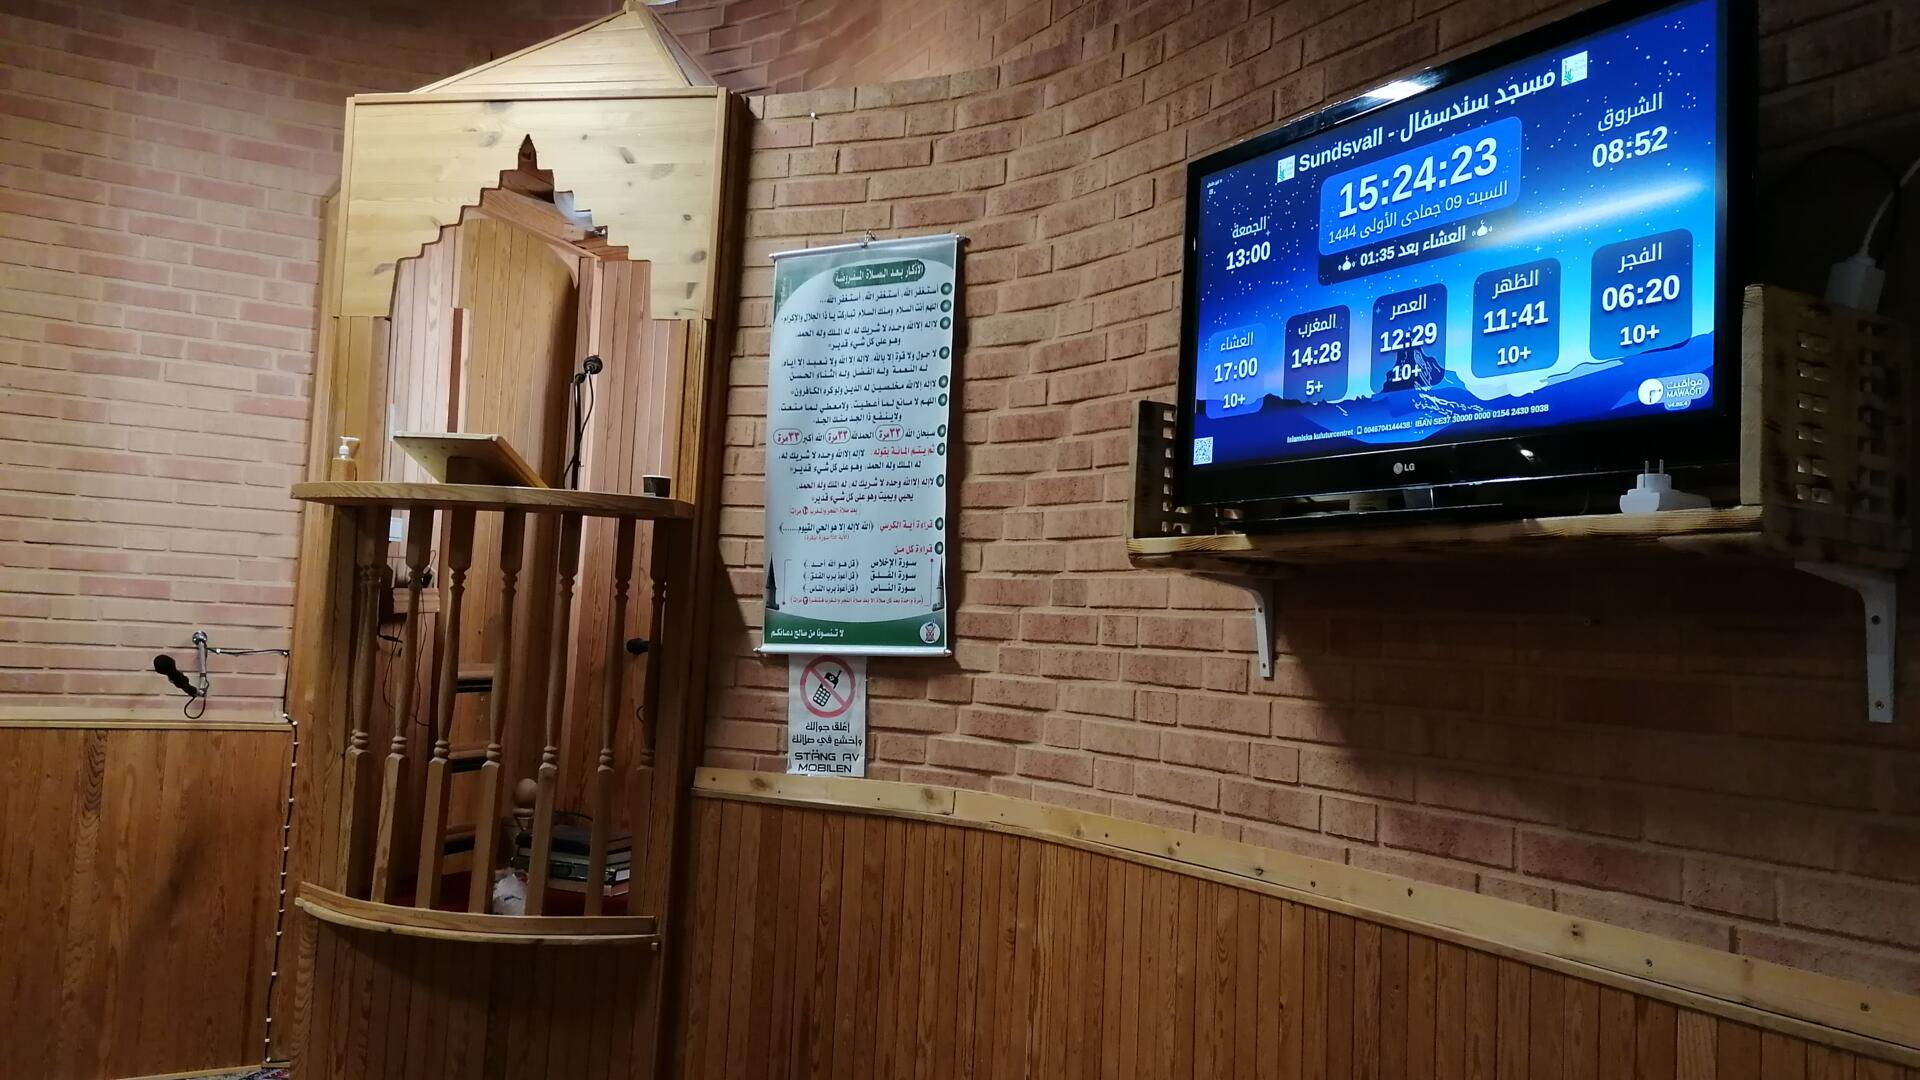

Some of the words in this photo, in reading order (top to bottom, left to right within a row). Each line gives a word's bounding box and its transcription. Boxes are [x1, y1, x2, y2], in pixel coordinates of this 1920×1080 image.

[1495, 68, 1556, 105] مسجد
[1400, 95, 1489, 142] سندسفال
[1597, 92, 1663, 132] الشروق
[1298, 127, 1384, 173] Sundsvall
[1592, 126, 1668, 167] 08:52
[1337, 136, 1499, 218] 15:24:23
[1445, 194, 1462, 211] 09
[1466, 180, 1508, 208] السبت
[1231, 215, 1267, 240] الجمعة
[1359, 212, 1397, 239] الأولى
[1401, 202, 1441, 228] جمادى
[1327, 225, 1358, 245] 1444
[1422, 225, 1466, 252] العشاء
[1225, 241, 1271, 271] 13:00
[1360, 246, 1396, 268] 01:35
[1397, 241, 1419, 258] بعد
[1617, 242, 1662, 274] الفجر
[1491, 269, 1539, 299] الظهر
[1601, 274, 1681, 312] 06:20
[1389, 293, 1427, 320] العصر
[1482, 300, 1549, 334] 11:41
[1298, 313, 1337, 338] المغرب
[1379, 322, 1438, 353] 12:29
[1220, 331, 1254, 352] العشاء
[1291, 340, 1342, 369] 14:28
[1214, 357, 1258, 383] 17:00
[1666, 377, 1703, 390] مواقيت
[1666, 387, 1704, 398] MAWAQIT
[1415, 418, 1433, 428] IBAN
[1433, 415, 1451, 426] SE37
[1452, 413, 1473, 424] 30000
[1474, 411, 1491, 421] 0000
[1492, 409, 1510, 418] 0154
[1511, 406, 1529, 416] 2430
[1530, 403, 1550, 414] 9038
[1403, 462, 1415, 472] LG
[792, 734, 815, 746] صلاتك
[805, 721, 830, 733] جوالك
[817, 735, 832, 746] في
[795, 749, 836, 761] STÄNG
[842, 753, 860, 762] AV
[797, 763, 852, 773] MOBILEN
